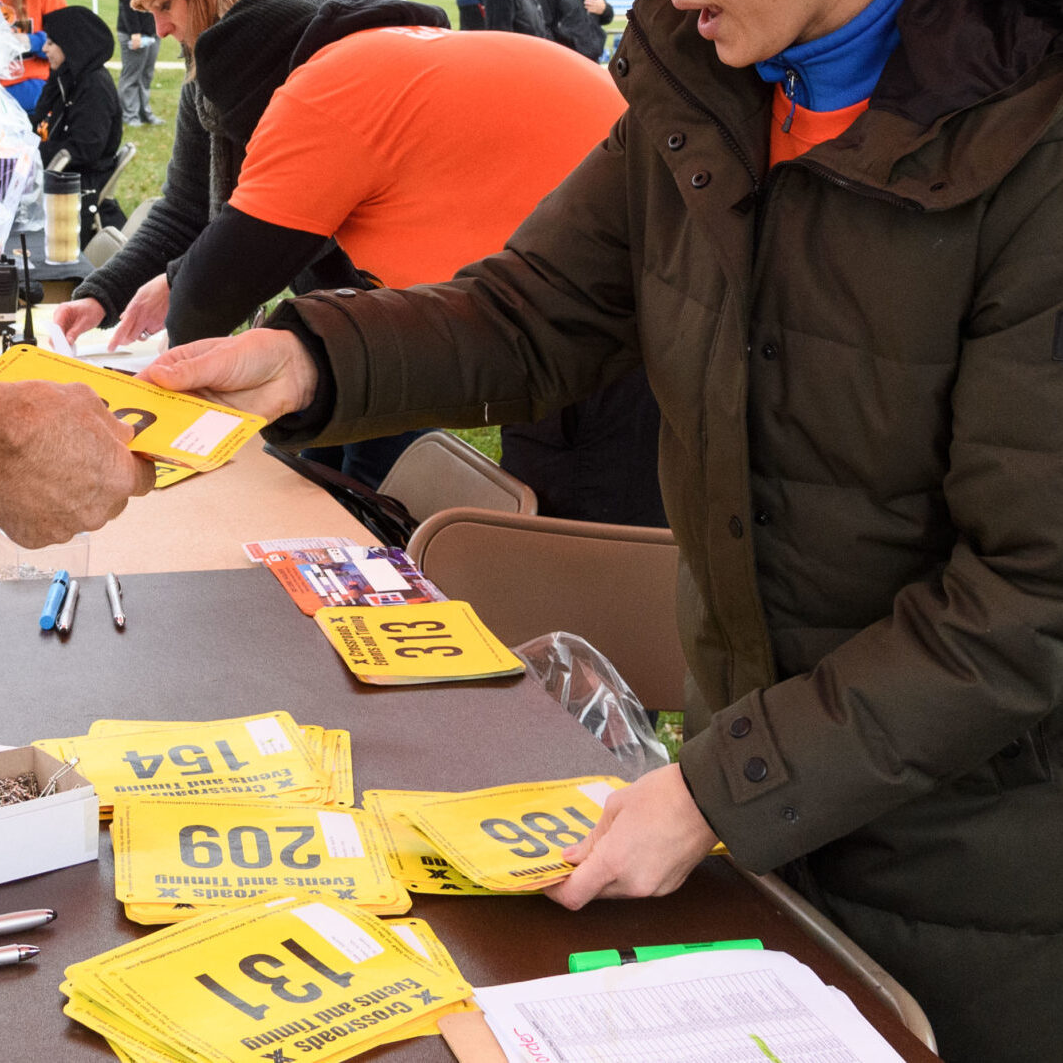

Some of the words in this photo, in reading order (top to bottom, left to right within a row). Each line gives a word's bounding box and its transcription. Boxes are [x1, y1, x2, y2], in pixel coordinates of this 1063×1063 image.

[350, 615, 371, 635] Timing
[336, 625, 364, 657] Crossroads
[361, 636, 379, 647] and
[379, 620, 463, 658] 313
[367, 648, 389, 666] Events
[122, 740, 250, 779] 154
[187, 777, 224, 788] and
[228, 768, 293, 784] Events
[114, 782, 184, 793] Timing
[151, 784, 266, 797] Crossroa
[480, 806, 597, 858] 186
[178, 824, 321, 870] 209
[154, 874, 233, 887] Timing
[237, 876, 279, 887] and
[283, 876, 356, 887] Events
[194, 937, 356, 1021] 131
[353, 977, 423, 1007] Events
[313, 1001, 356, 1024] and
[240, 1017, 321, 1051] Timing
[293, 1000, 413, 1052] Crossroads
